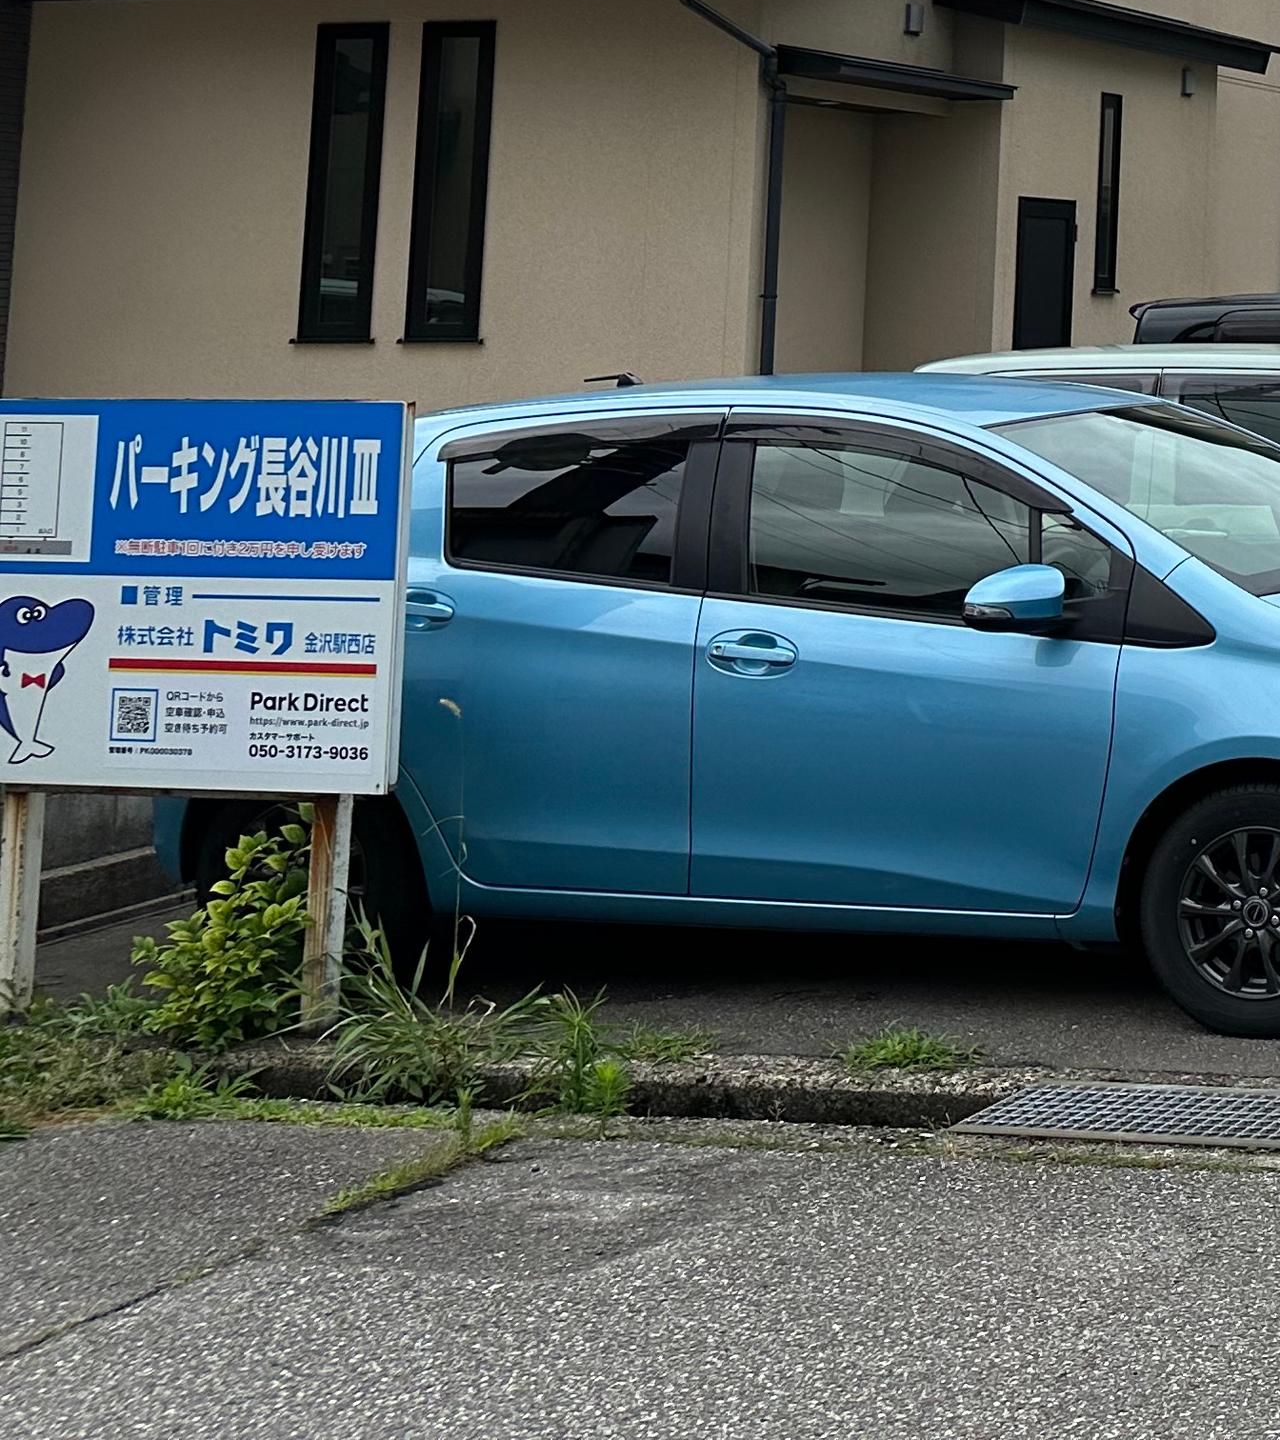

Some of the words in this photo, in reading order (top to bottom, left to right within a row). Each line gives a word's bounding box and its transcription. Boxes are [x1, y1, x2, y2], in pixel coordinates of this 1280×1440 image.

[117, 625, 195, 647] 株式会社
[202, 619, 294, 656] トミワ
[304, 631, 377, 655] 金沢駅西店
[250, 691, 300, 711] Park
[303, 692, 369, 713] Direct
[249, 716, 370, 730] https://www.park-direct.jp
[248, 743, 370, 761] 050-3173-9036
